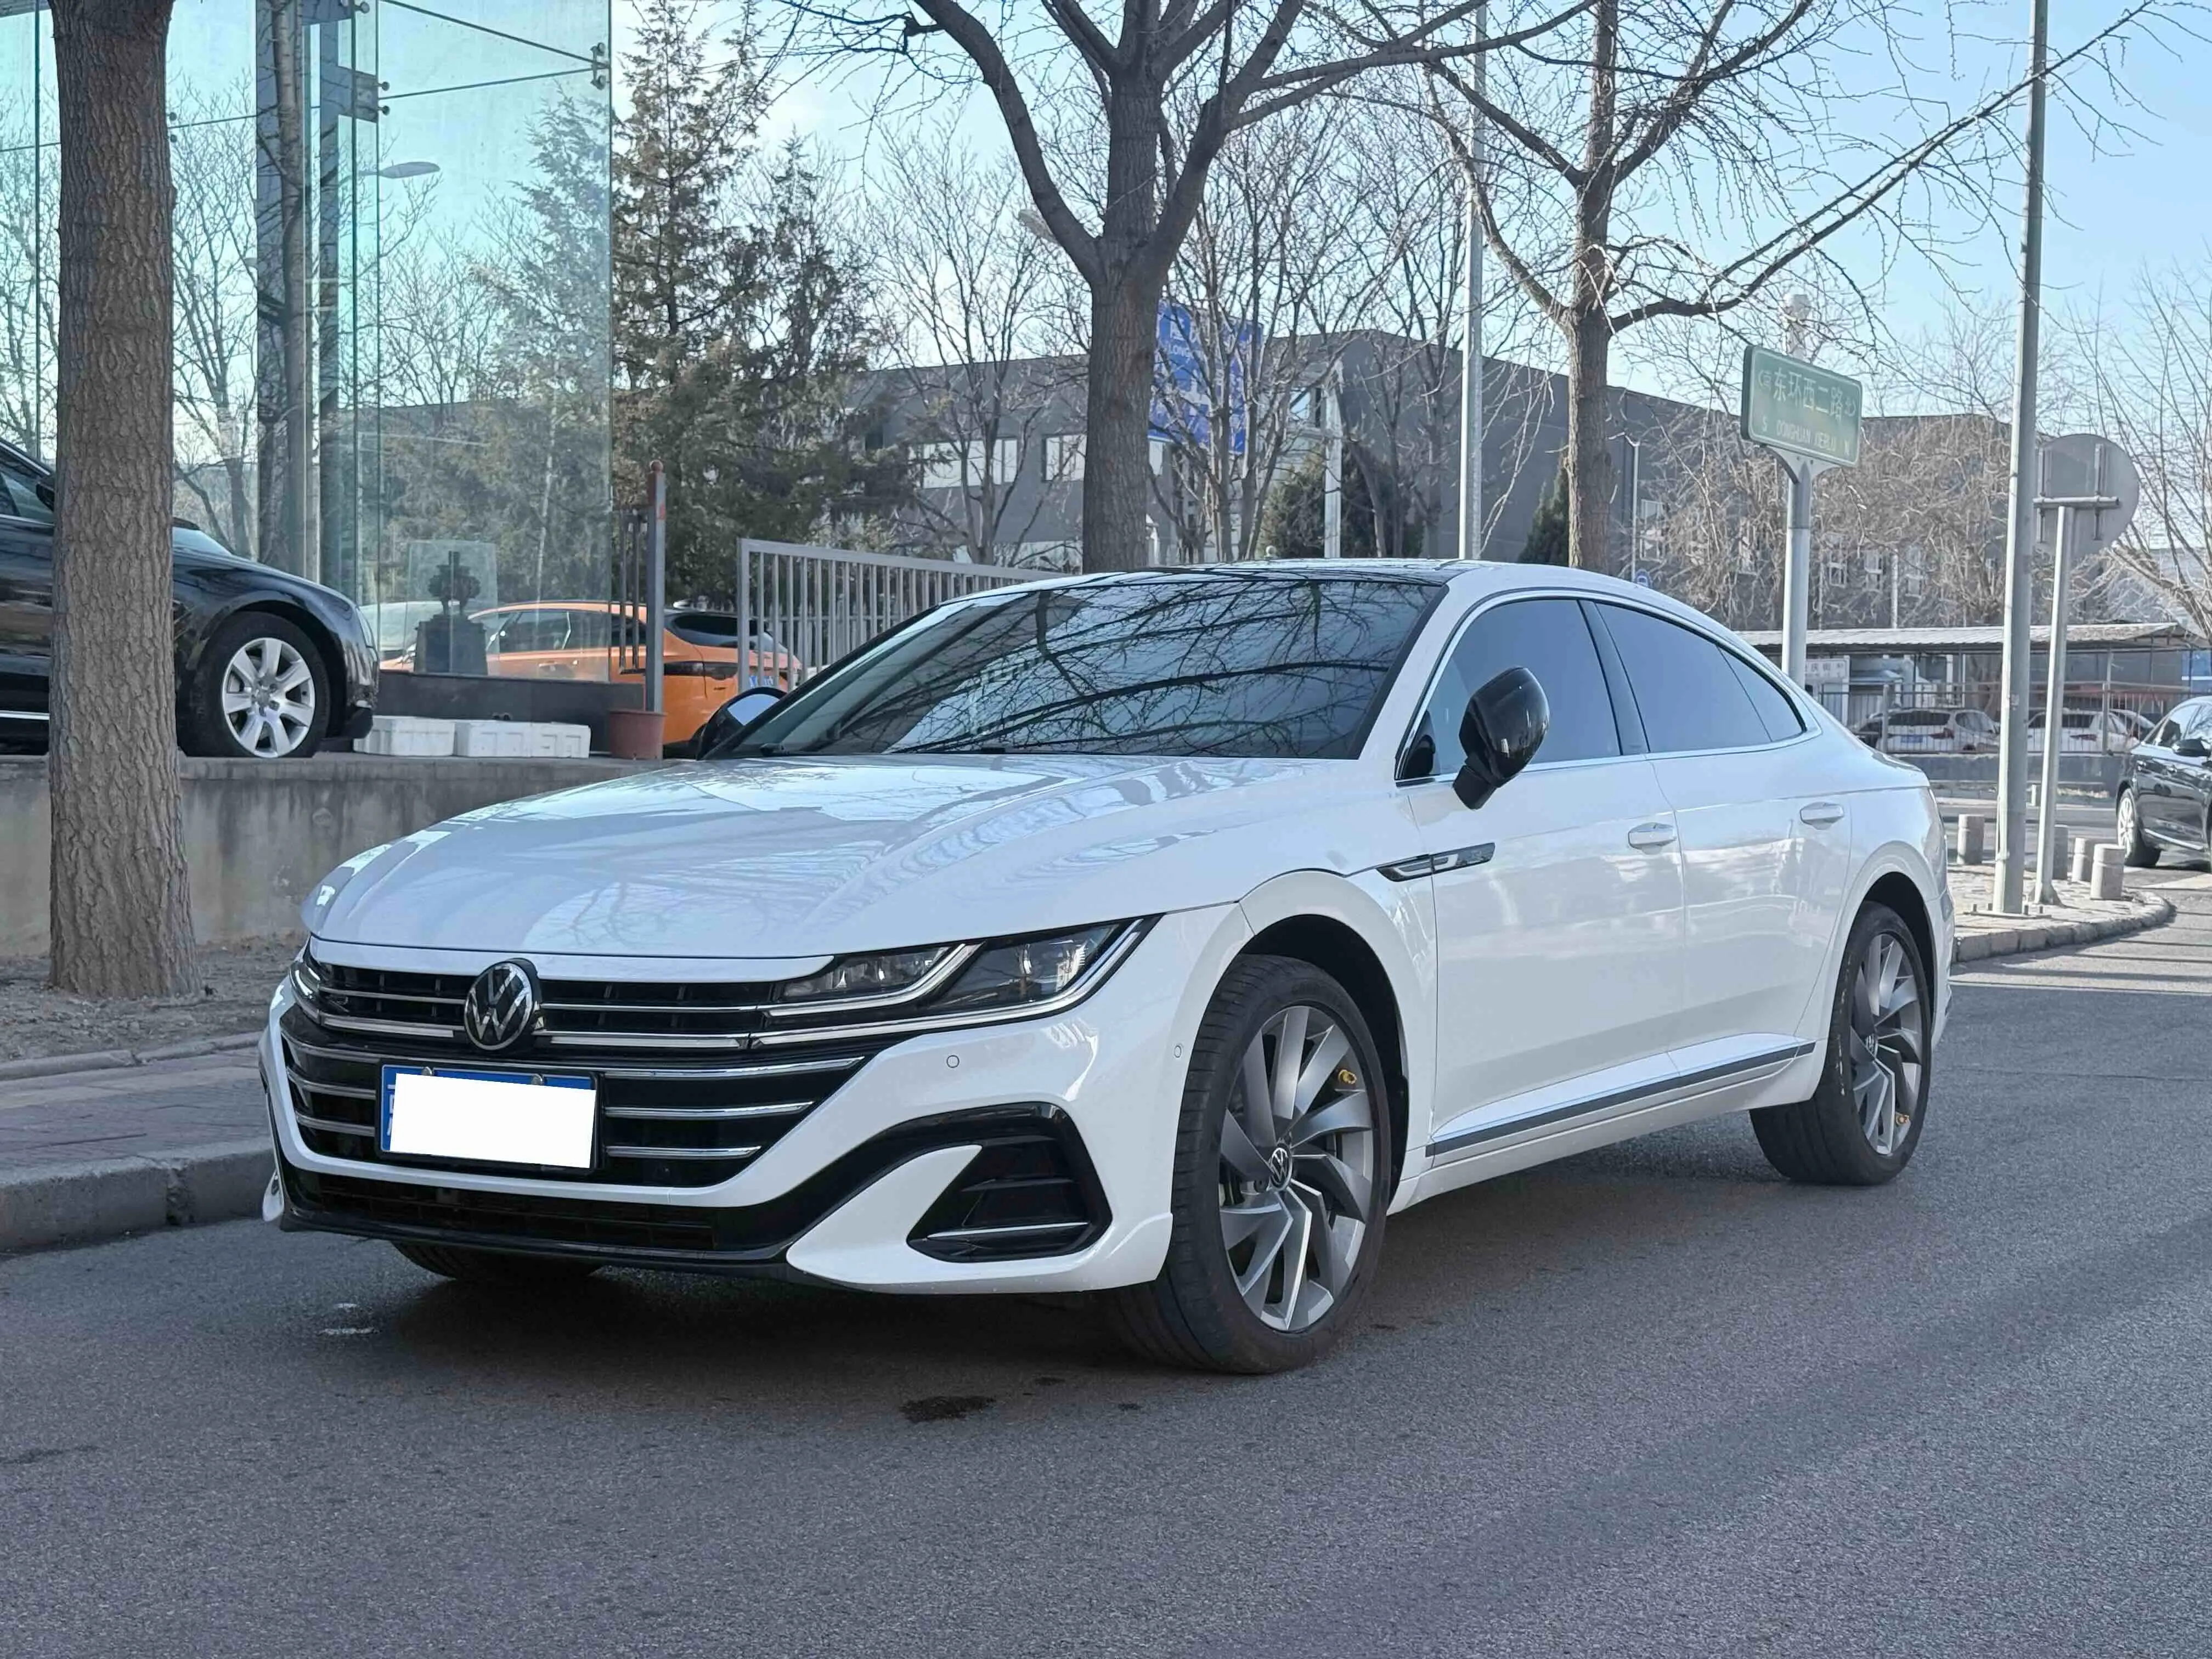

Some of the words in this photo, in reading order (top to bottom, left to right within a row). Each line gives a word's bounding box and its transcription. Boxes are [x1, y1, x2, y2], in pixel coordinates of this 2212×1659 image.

[1773, 367, 1843, 423] 东环西二路
